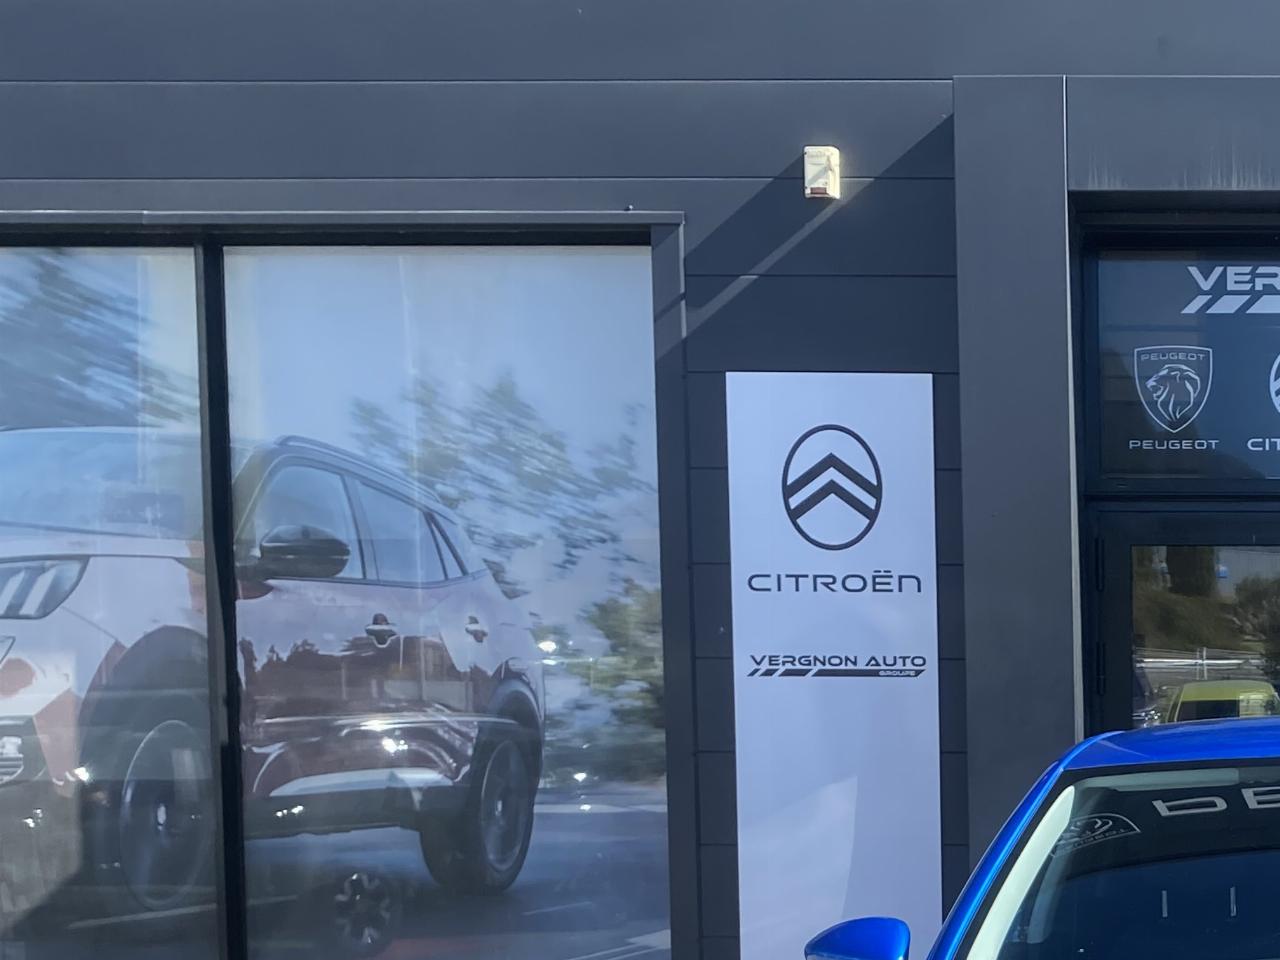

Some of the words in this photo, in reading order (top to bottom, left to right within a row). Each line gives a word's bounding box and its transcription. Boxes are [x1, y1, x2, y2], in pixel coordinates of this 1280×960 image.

[1140, 351, 1206, 362] PEUGEOT
[1129, 439, 1219, 450] PEUGEOT
[748, 570, 922, 593] CITROËN
[750, 654, 858, 667] VERGNON
[864, 655, 926, 667] AUTO
